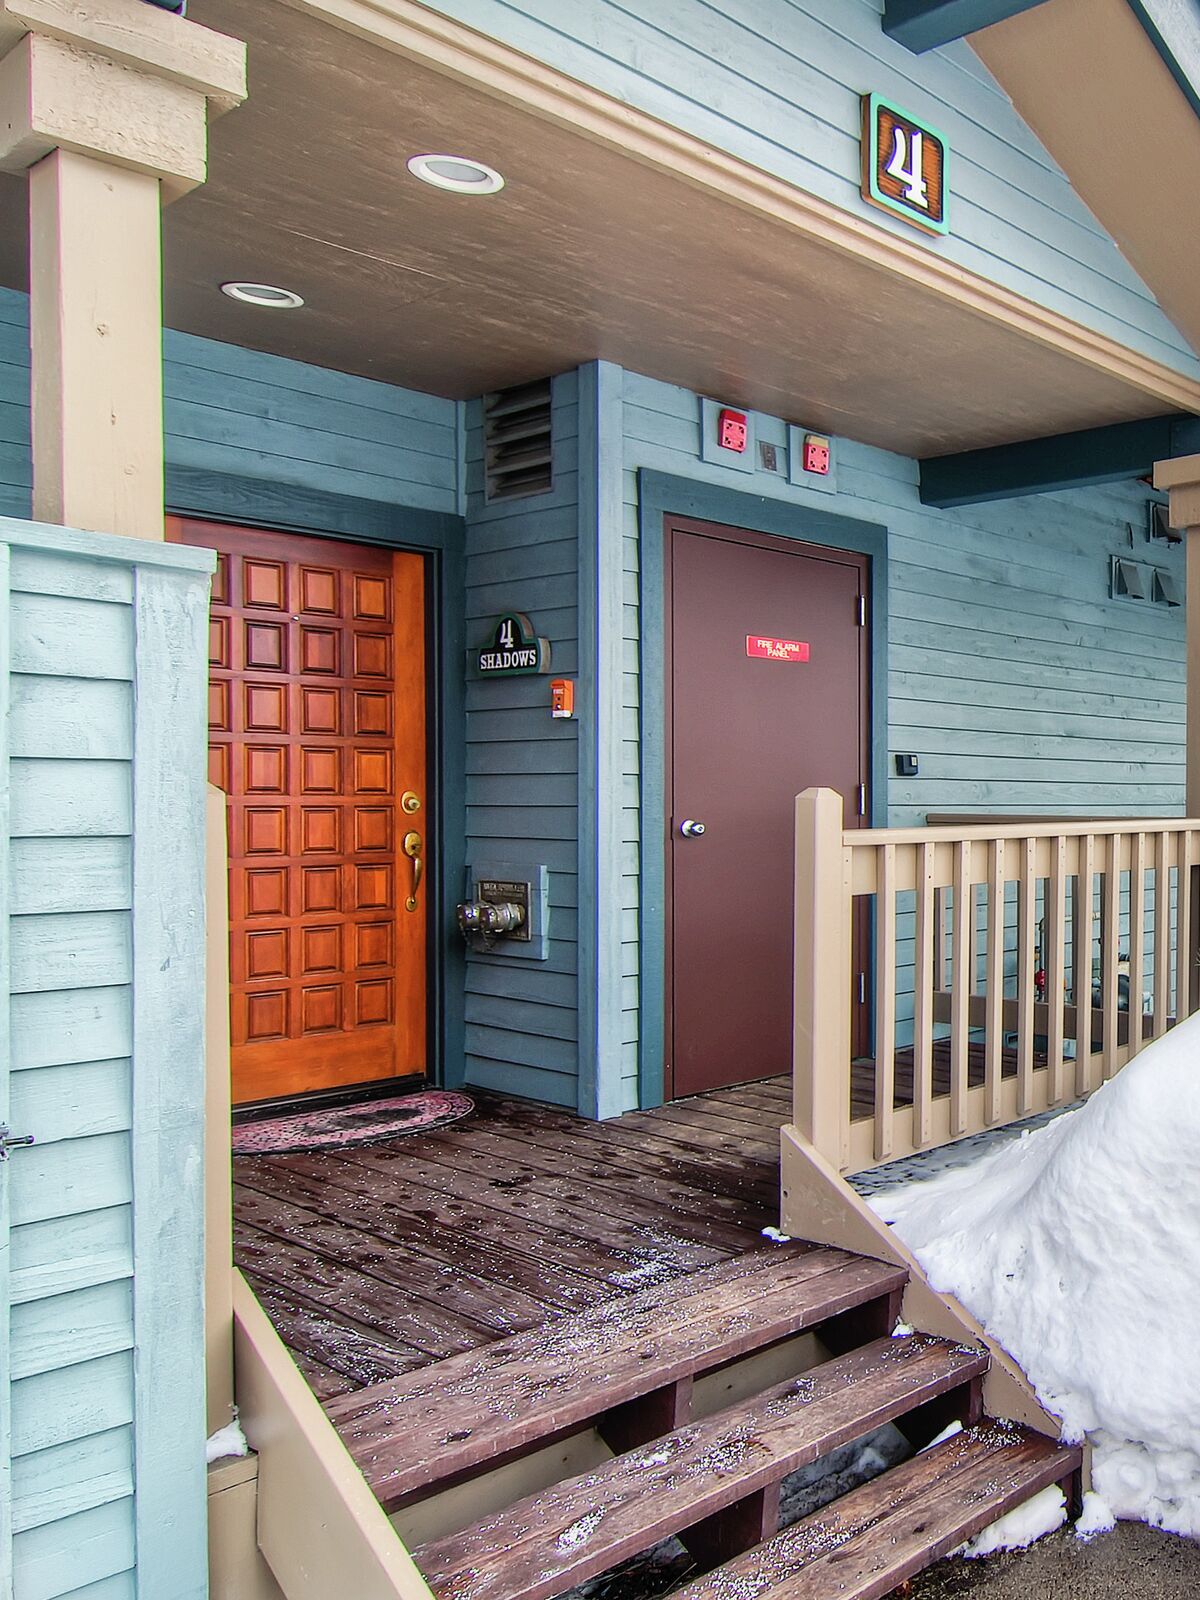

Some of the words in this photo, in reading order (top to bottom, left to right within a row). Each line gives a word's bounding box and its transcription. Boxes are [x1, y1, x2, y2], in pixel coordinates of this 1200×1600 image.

[886, 128, 929, 209] 4
[500, 620, 514, 648] 4
[757, 640, 773, 649] FIRE
[775, 642, 800, 652] ALARM
[767, 648, 790, 658] PANEL
[480, 649, 537, 670] SHADOWS
